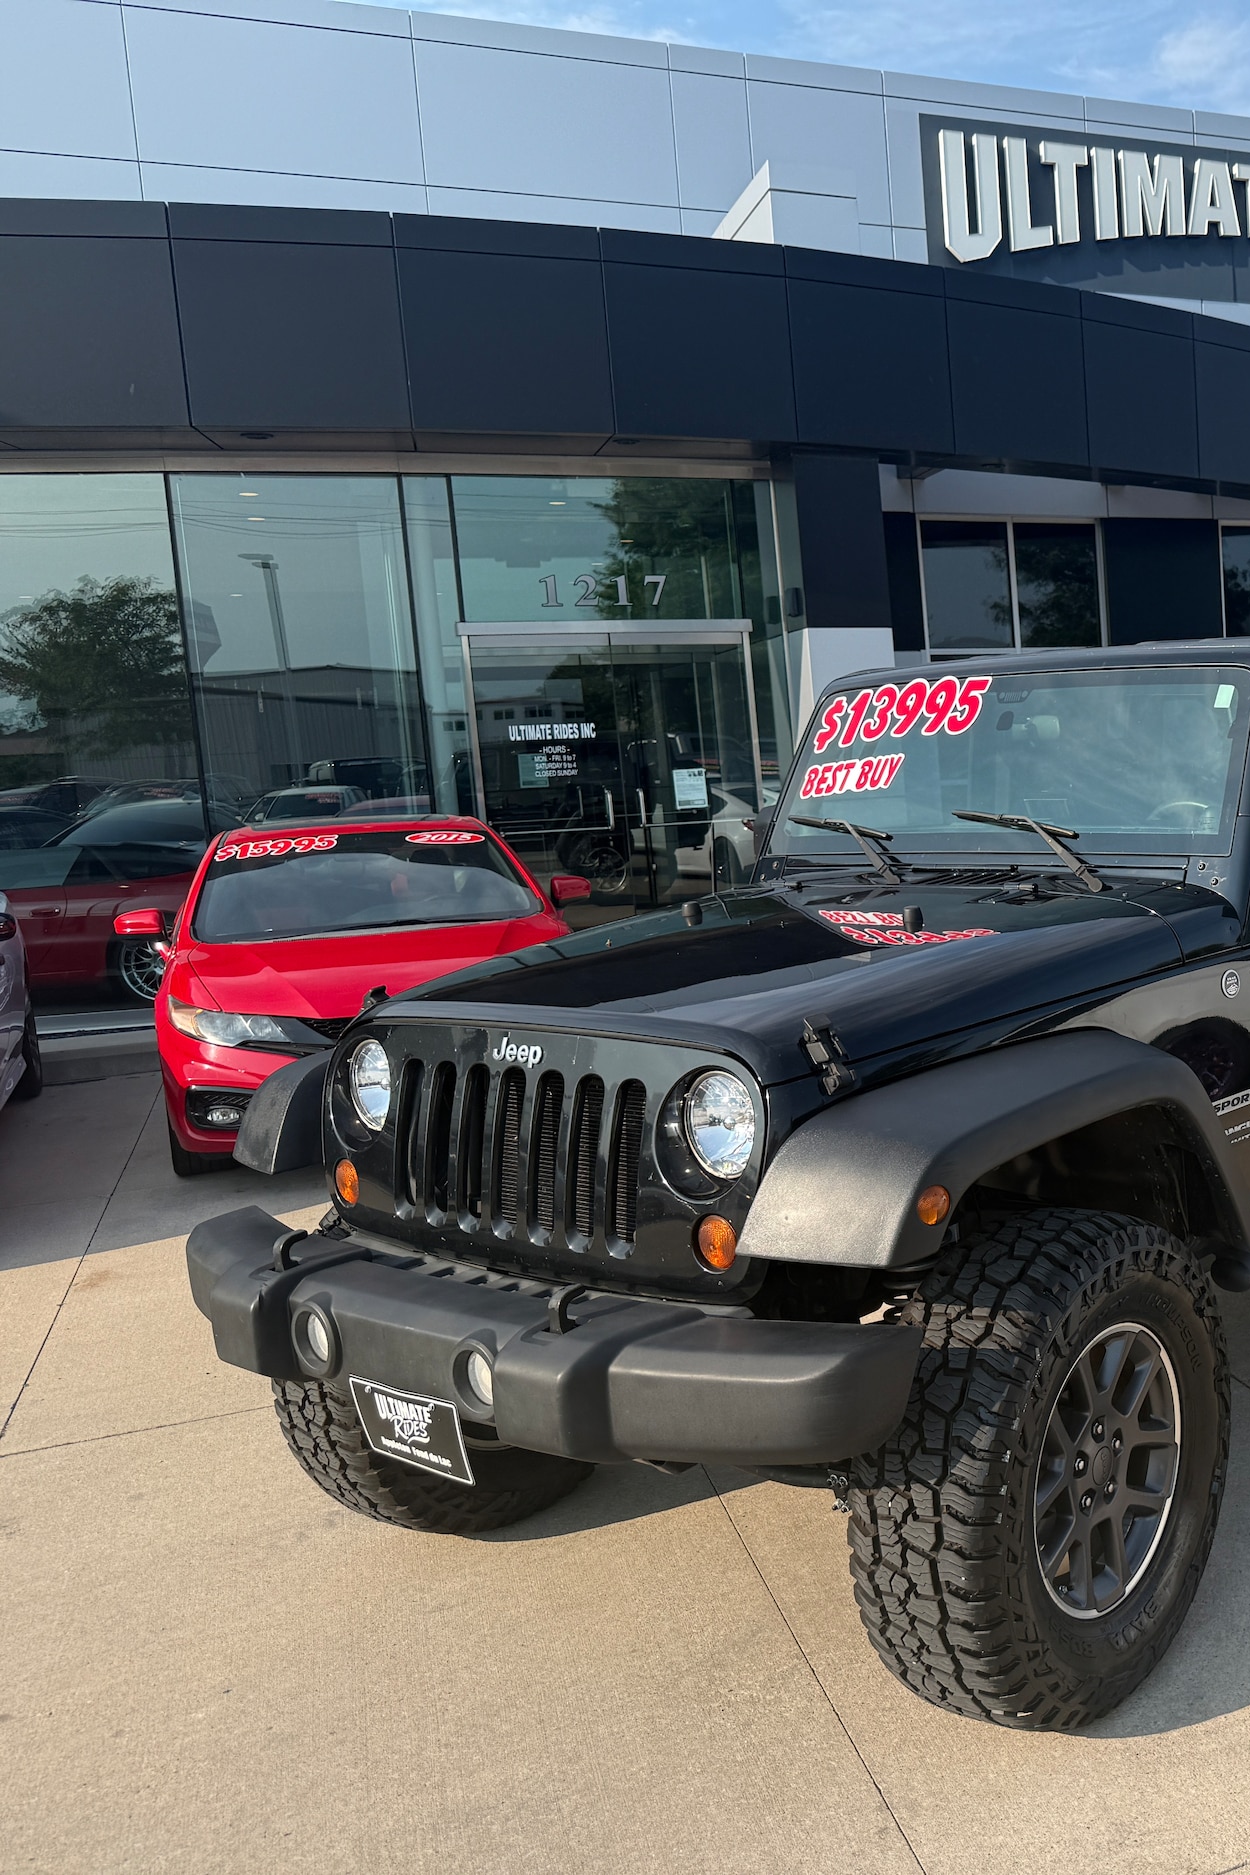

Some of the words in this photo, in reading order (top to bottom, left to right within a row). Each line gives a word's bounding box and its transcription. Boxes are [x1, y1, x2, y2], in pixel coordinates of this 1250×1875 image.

[539, 574, 667, 607] 1217
[814, 675, 992, 754] $13995
[508, 724, 552, 741] ULTIMATE
[553, 722, 580, 740] RIDES
[580, 722, 596, 739] INC
[542, 745, 567, 754] HOURS
[535, 762, 563, 770] SATURDAY
[535, 770, 557, 778] CLOSED
[800, 759, 856, 799] BEST
[855, 753, 905, 792] BUY
[214, 834, 339, 862] $15995
[492, 1036, 543, 1068] Jeep
[374, 1392, 432, 1423] ULTIMATE
